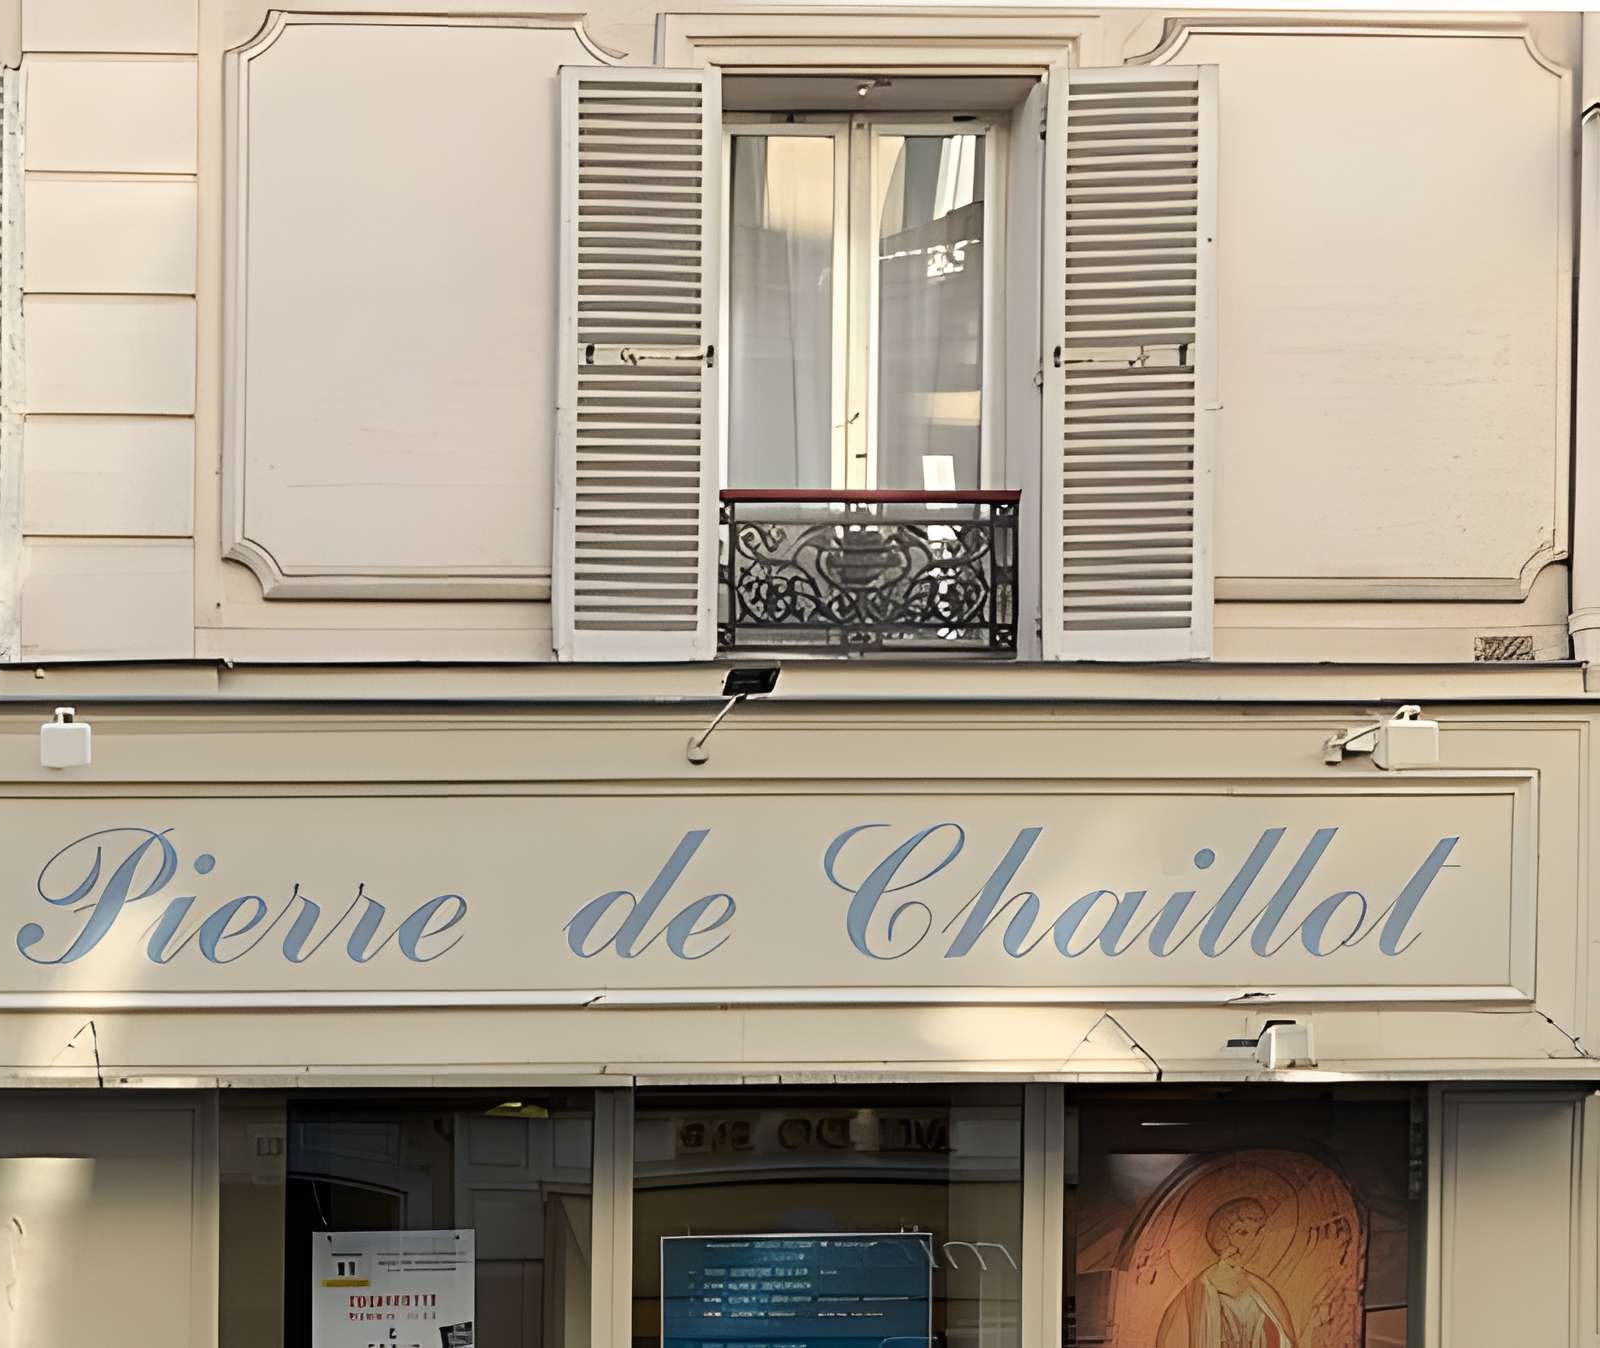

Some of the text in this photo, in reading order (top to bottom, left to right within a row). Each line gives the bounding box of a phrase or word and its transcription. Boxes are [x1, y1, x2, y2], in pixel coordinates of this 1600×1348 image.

[14, 826, 468, 965] Pierre
[563, 828, 737, 961] de
[822, 822, 1462, 961] Chaillot
